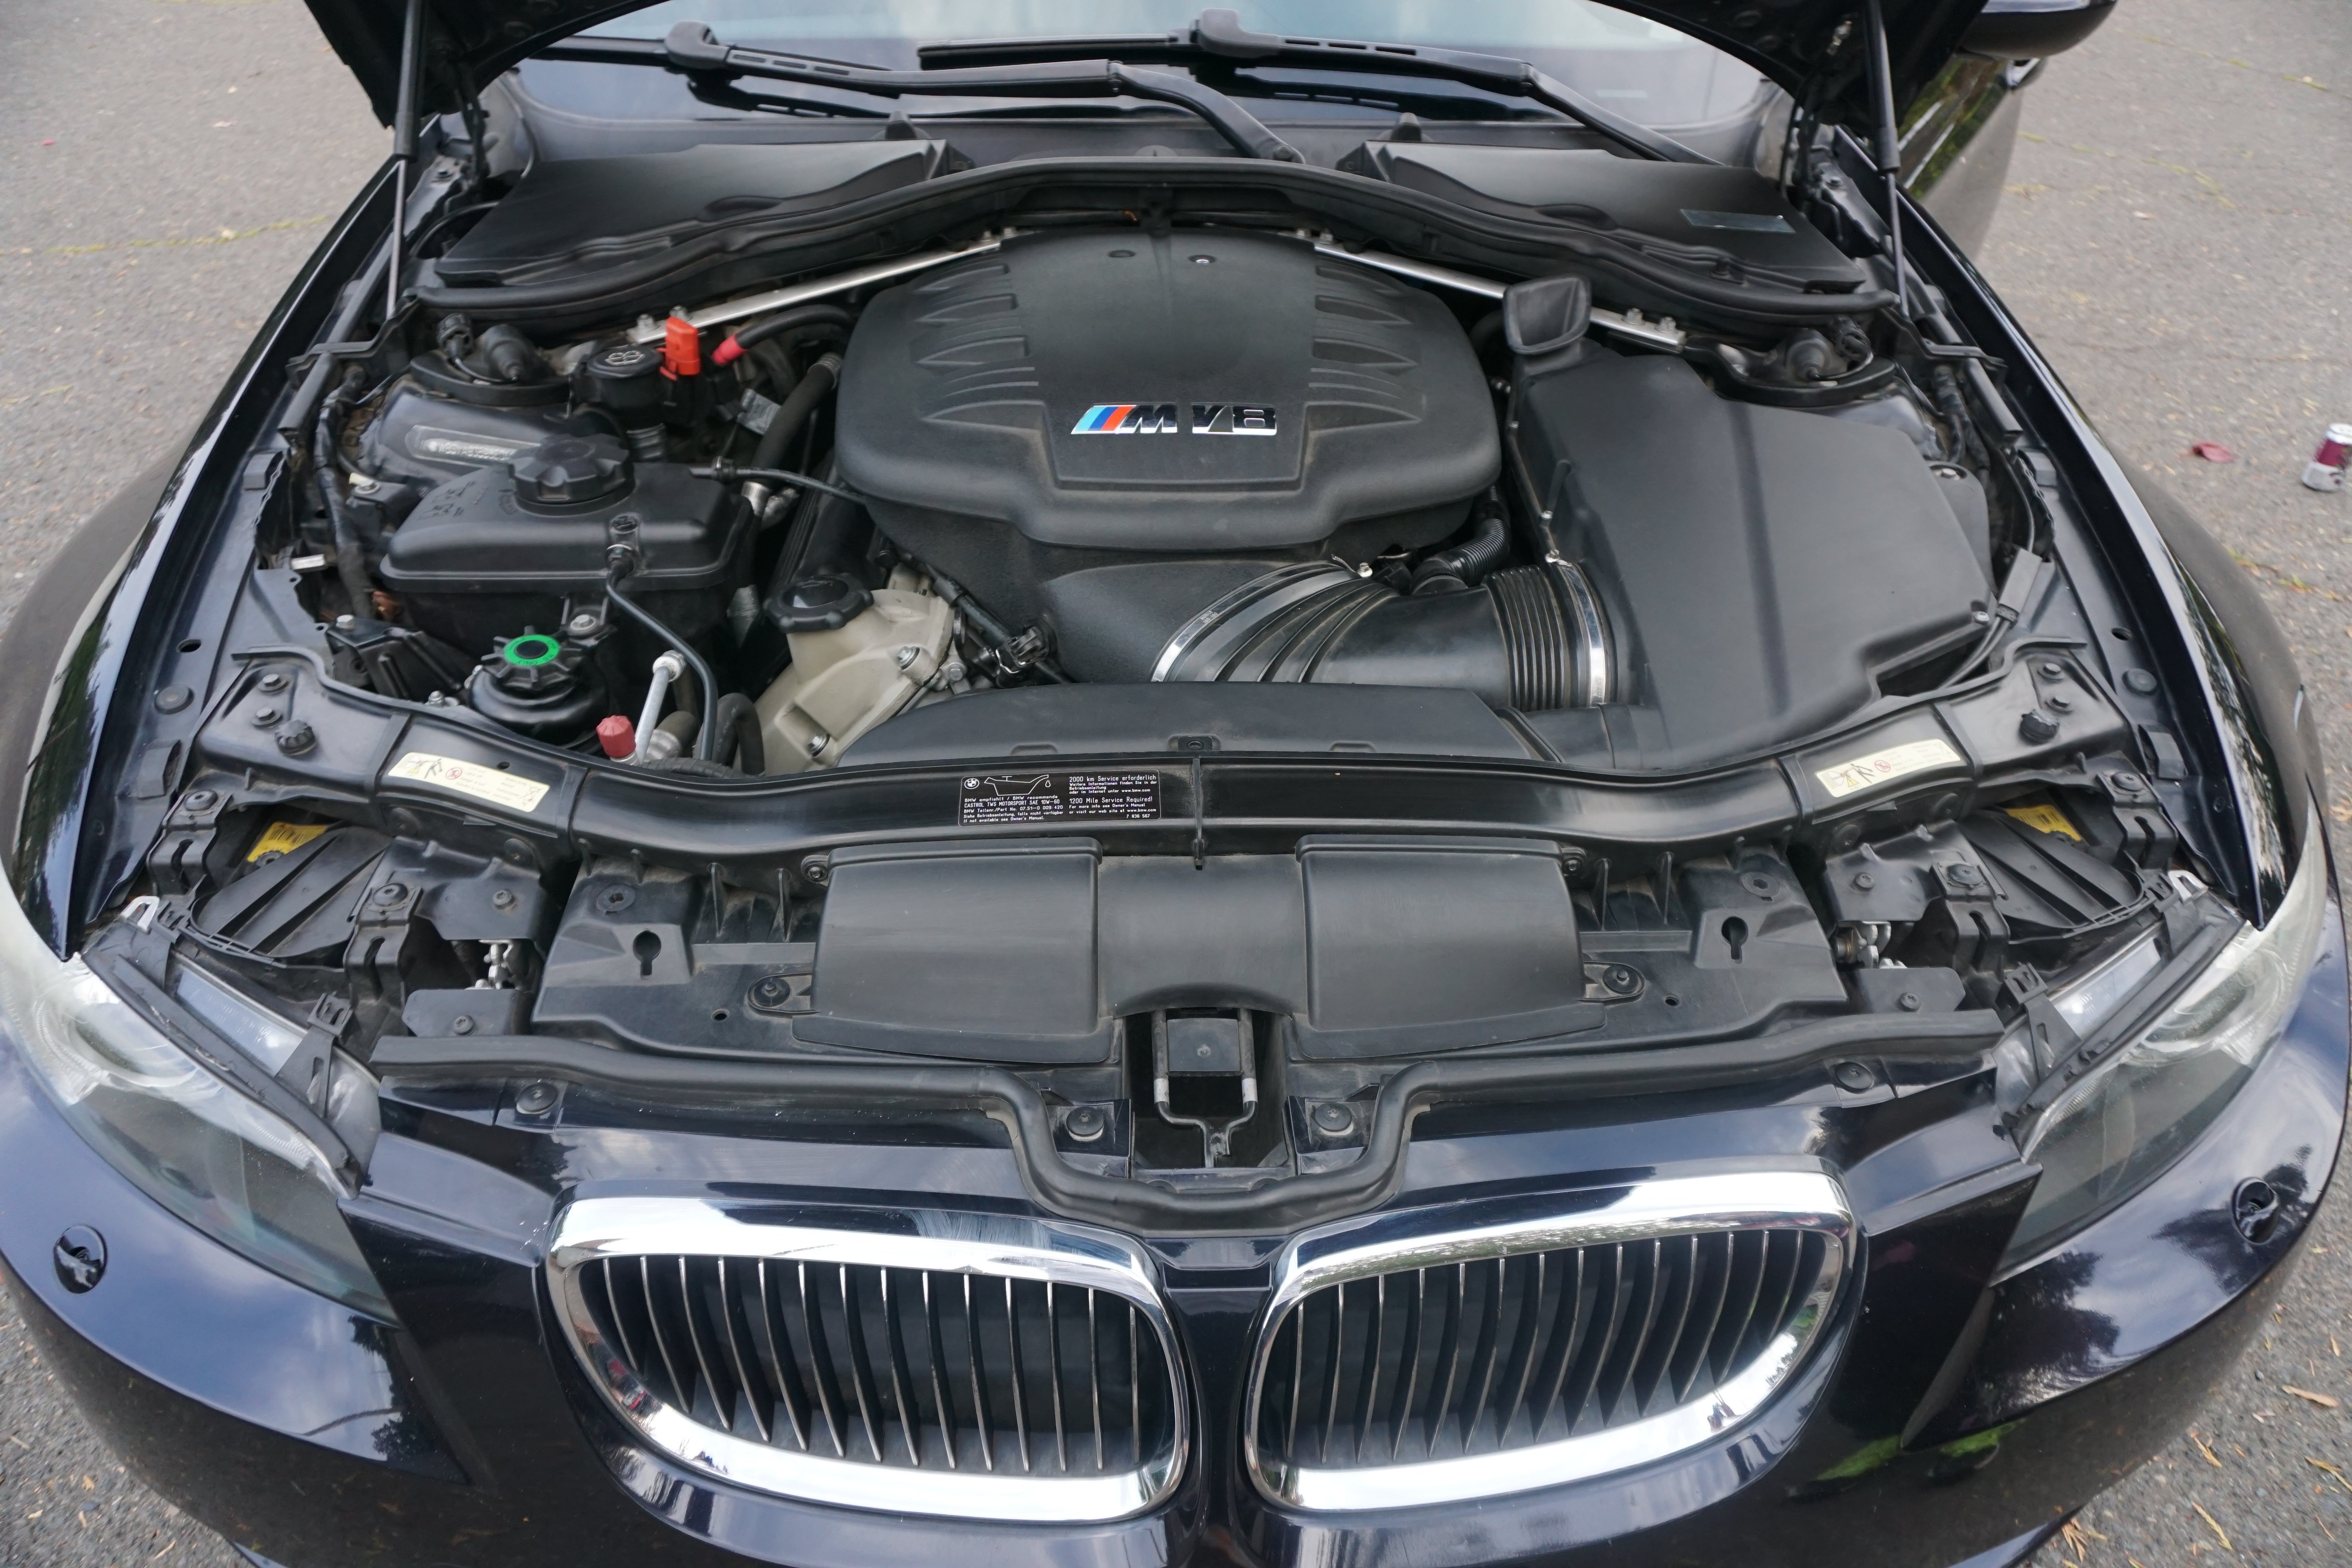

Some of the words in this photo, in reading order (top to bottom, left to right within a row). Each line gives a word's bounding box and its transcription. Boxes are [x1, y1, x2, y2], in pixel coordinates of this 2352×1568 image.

[1115, 403, 1177, 434] M
[1191, 403, 1277, 435] V8
[1200, 611, 1213, 620] NORMA
